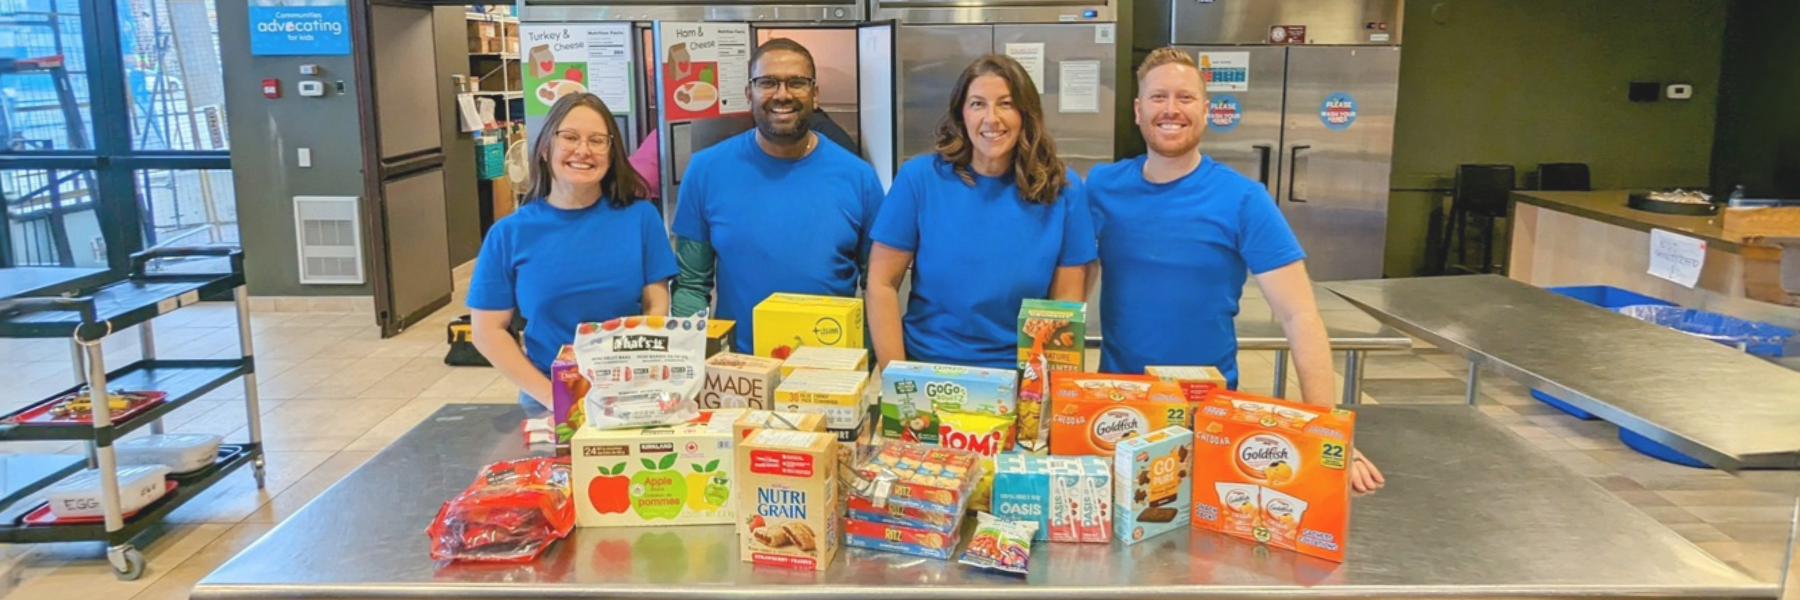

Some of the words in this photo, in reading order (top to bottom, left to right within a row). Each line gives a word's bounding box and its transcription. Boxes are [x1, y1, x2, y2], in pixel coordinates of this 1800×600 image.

[275, 11, 322, 19] Communities
[257, 18, 342, 35] advocating
[676, 28, 696, 38] Ham
[697, 26, 704, 38] &
[528, 30, 561, 42] Turkey
[563, 28, 571, 40] &
[553, 42, 585, 52] Cheese
[689, 40, 716, 51] Cheese
[1210, 102, 1236, 110] PLEASE
[1326, 101, 1352, 109] PLEASE
[704, 373, 763, 399] MADE
[926, 383, 960, 398] GoGo
[704, 391, 763, 411] GOOD
[788, 392, 800, 402] 30
[1053, 414, 1086, 425] CHEDDAR
[1167, 408, 1185, 419] 22
[1096, 421, 1139, 437] Goldfish
[1196, 431, 1231, 446] CHEDDAR
[584, 447, 598, 456] 24
[641, 443, 673, 451] KIRKLAND
[1322, 443, 1343, 458] 22
[1242, 446, 1289, 461] Goldfish
[1153, 456, 1175, 476] GO
[645, 476, 673, 487] Apple
[1153, 472, 1175, 485] PURE
[757, 487, 806, 504] NUTRI
[894, 485, 912, 497] RITZ
[63, 498, 99, 510] EGG
[638, 497, 680, 508] pommes
[1000, 501, 1042, 516] OASIS
[757, 503, 807, 520] GRAIN
[1054, 494, 1064, 527] OASIS
[1083, 496, 1093, 527] OASIS
[885, 528, 903, 540] RITZ
[1256, 528, 1269, 539] 22
